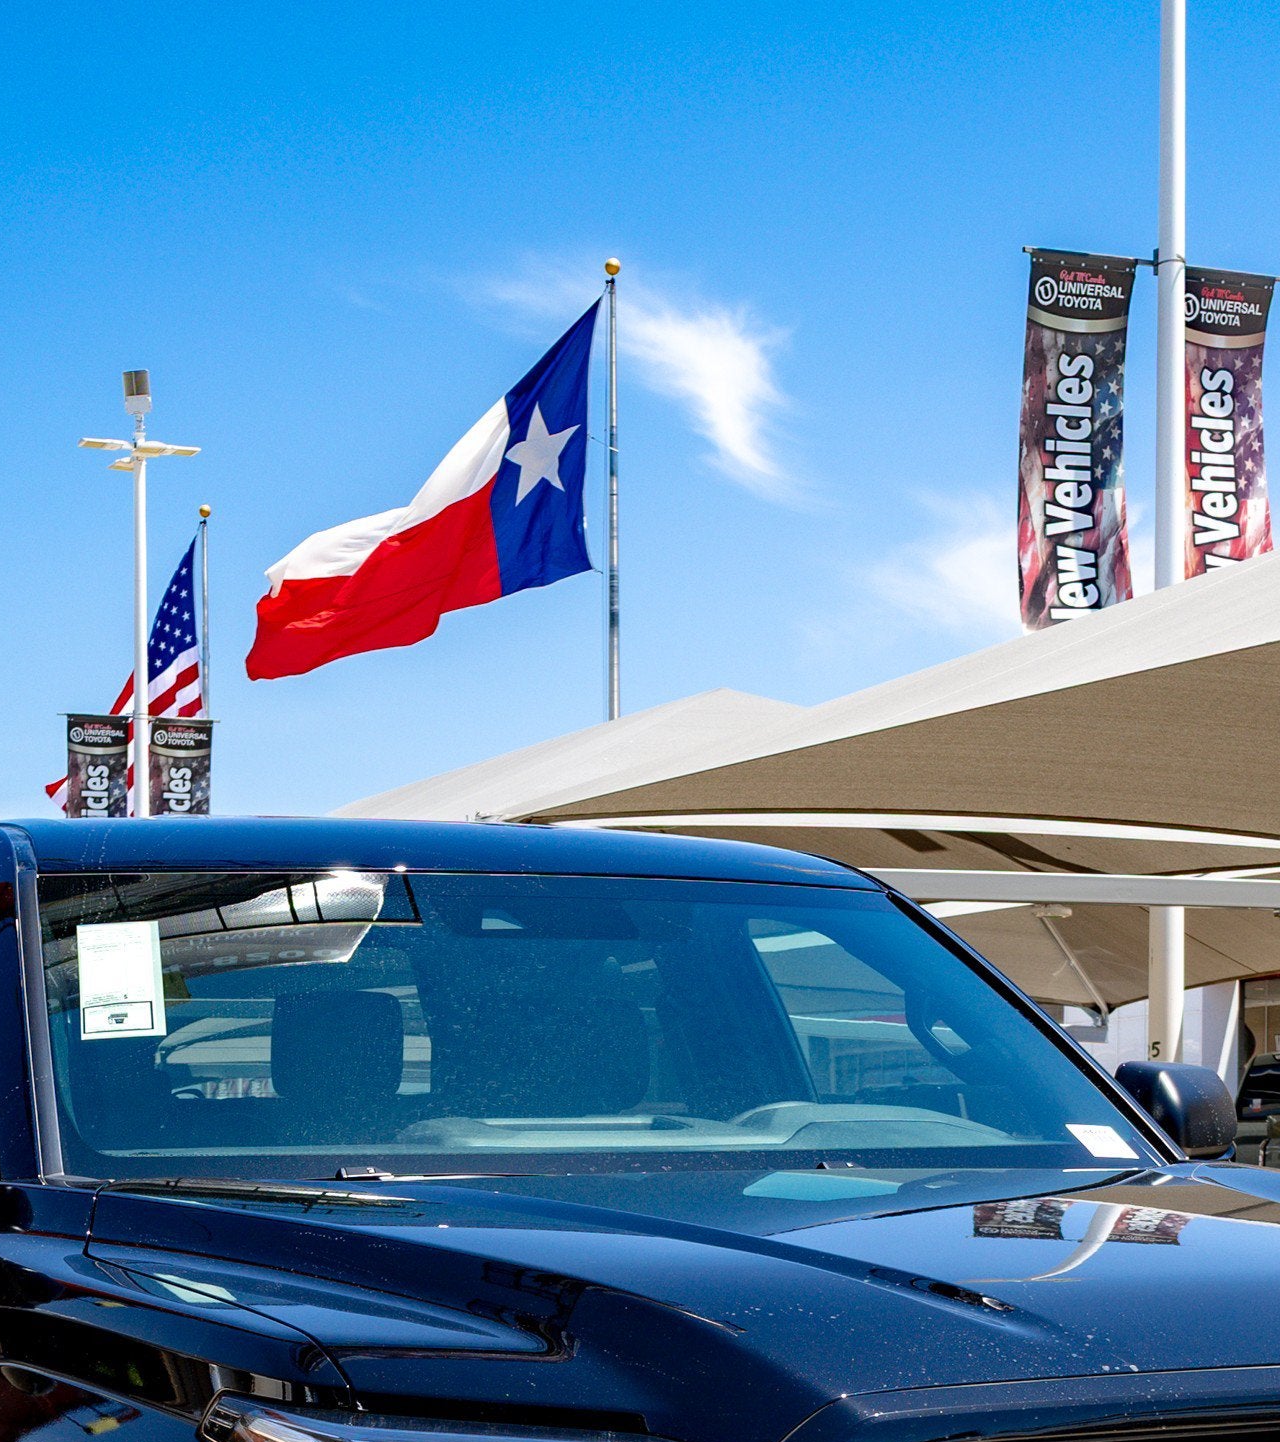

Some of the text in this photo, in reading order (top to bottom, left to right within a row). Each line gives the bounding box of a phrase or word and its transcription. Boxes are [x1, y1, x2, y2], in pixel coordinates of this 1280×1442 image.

[1059, 281, 1125, 299] UNIVERSAL
[1058, 295, 1102, 311] TOYOTA
[1200, 298, 1262, 316] UNIVERSAL
[1200, 311, 1240, 327] TOYOTA
[1043, 353, 1097, 538] Vehicles
[1191, 368, 1240, 545] Vehicles
[84, 729, 125, 738] UNIVERSAL
[84, 735, 112, 744] TOYOTA
[168, 732, 209, 740] UNIVERSAL
[168, 738, 195, 746] TOYOTA
[81, 764, 110, 817] icles
